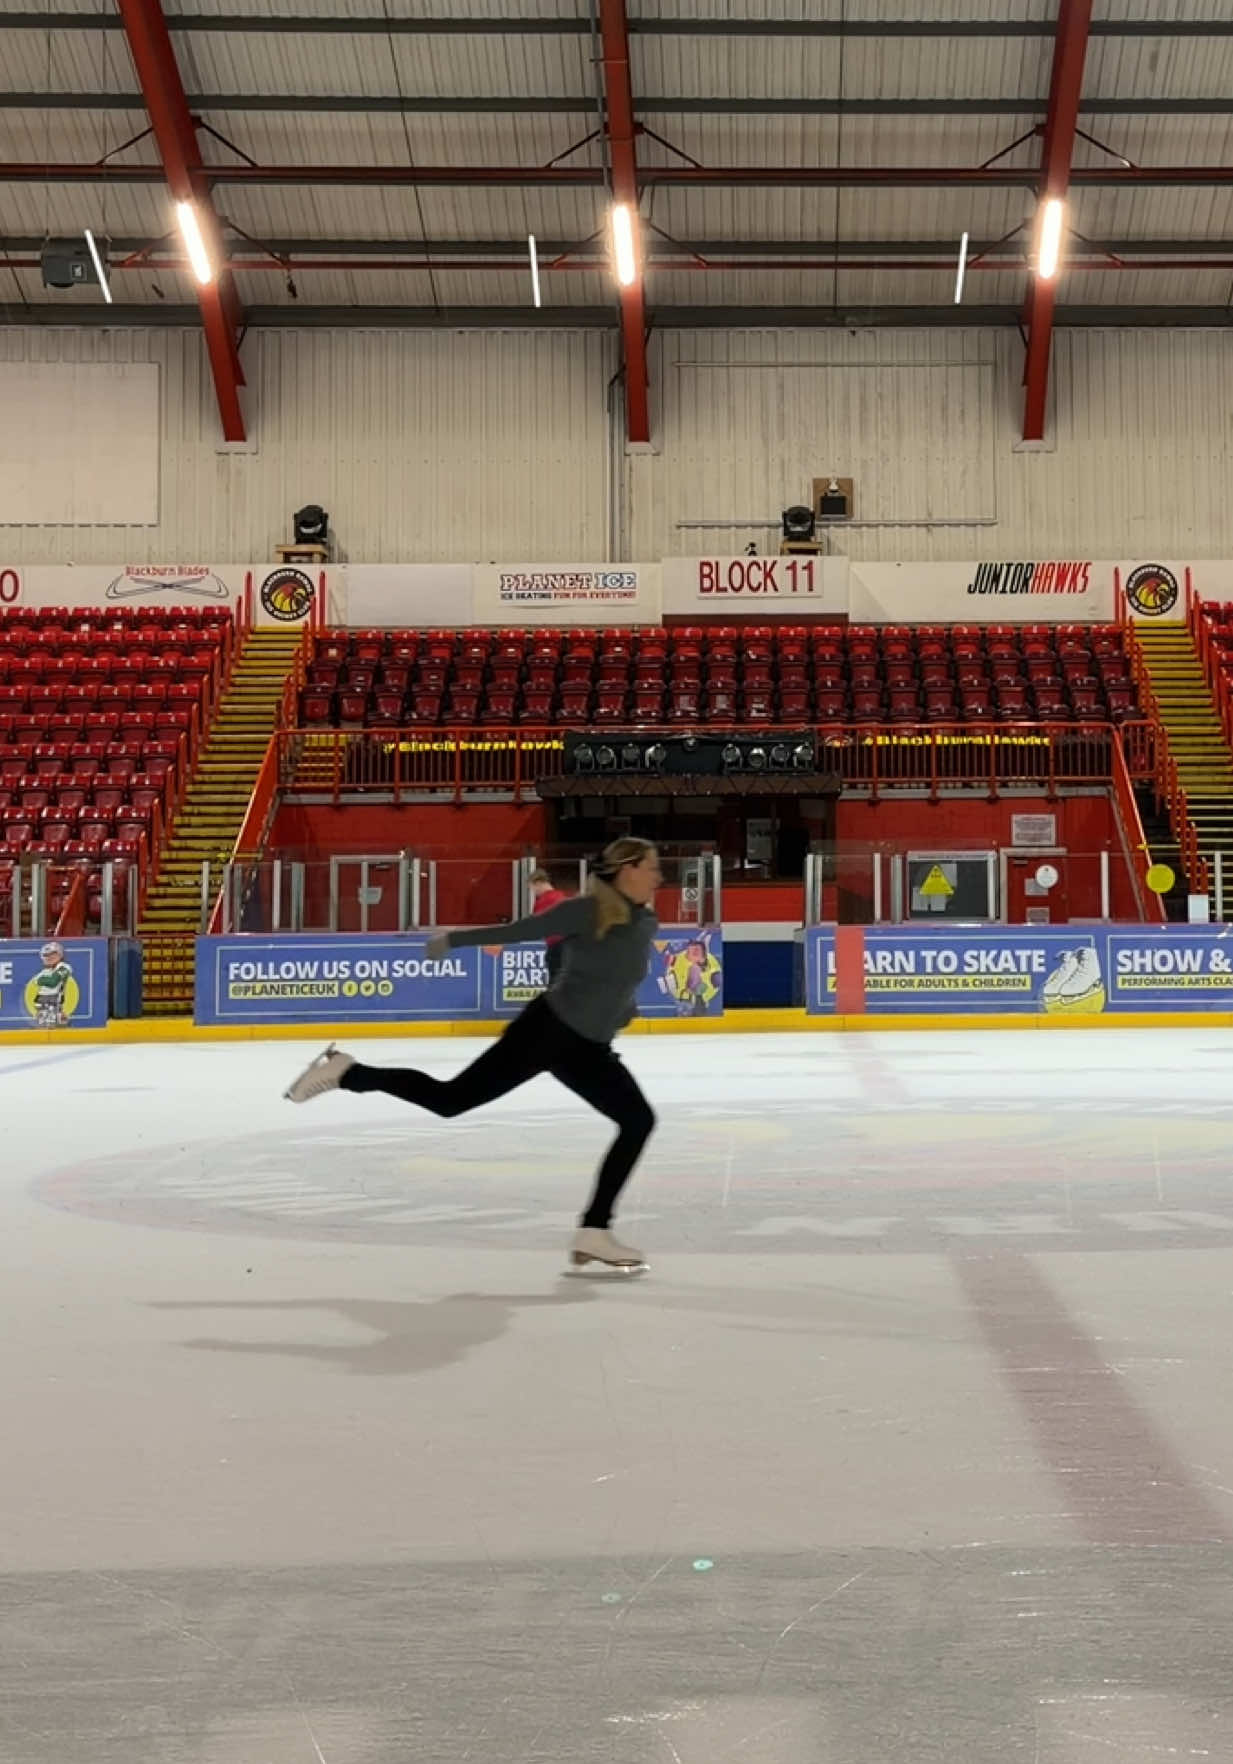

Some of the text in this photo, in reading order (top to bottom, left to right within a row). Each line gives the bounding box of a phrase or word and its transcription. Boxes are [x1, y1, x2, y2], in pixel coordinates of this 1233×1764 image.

[126, 566, 209, 576] Blackburn Blades
[700, 560, 814, 593] BLOCK 11
[501, 572, 636, 591] PLANET ICE
[229, 959, 467, 980] FOLLOW US ON SOCIAL
[827, 950, 1046, 974] LARN TO SKATE
[1117, 949, 1232, 973] SHOW &
[231, 982, 336, 997] @PLANETICEUK
[895, 979, 914, 988] FOR
[918, 979, 959, 988] ADULTS
[972, 978, 1027, 987] CHILDREN
[1121, 977, 1185, 986] PERFORMING
